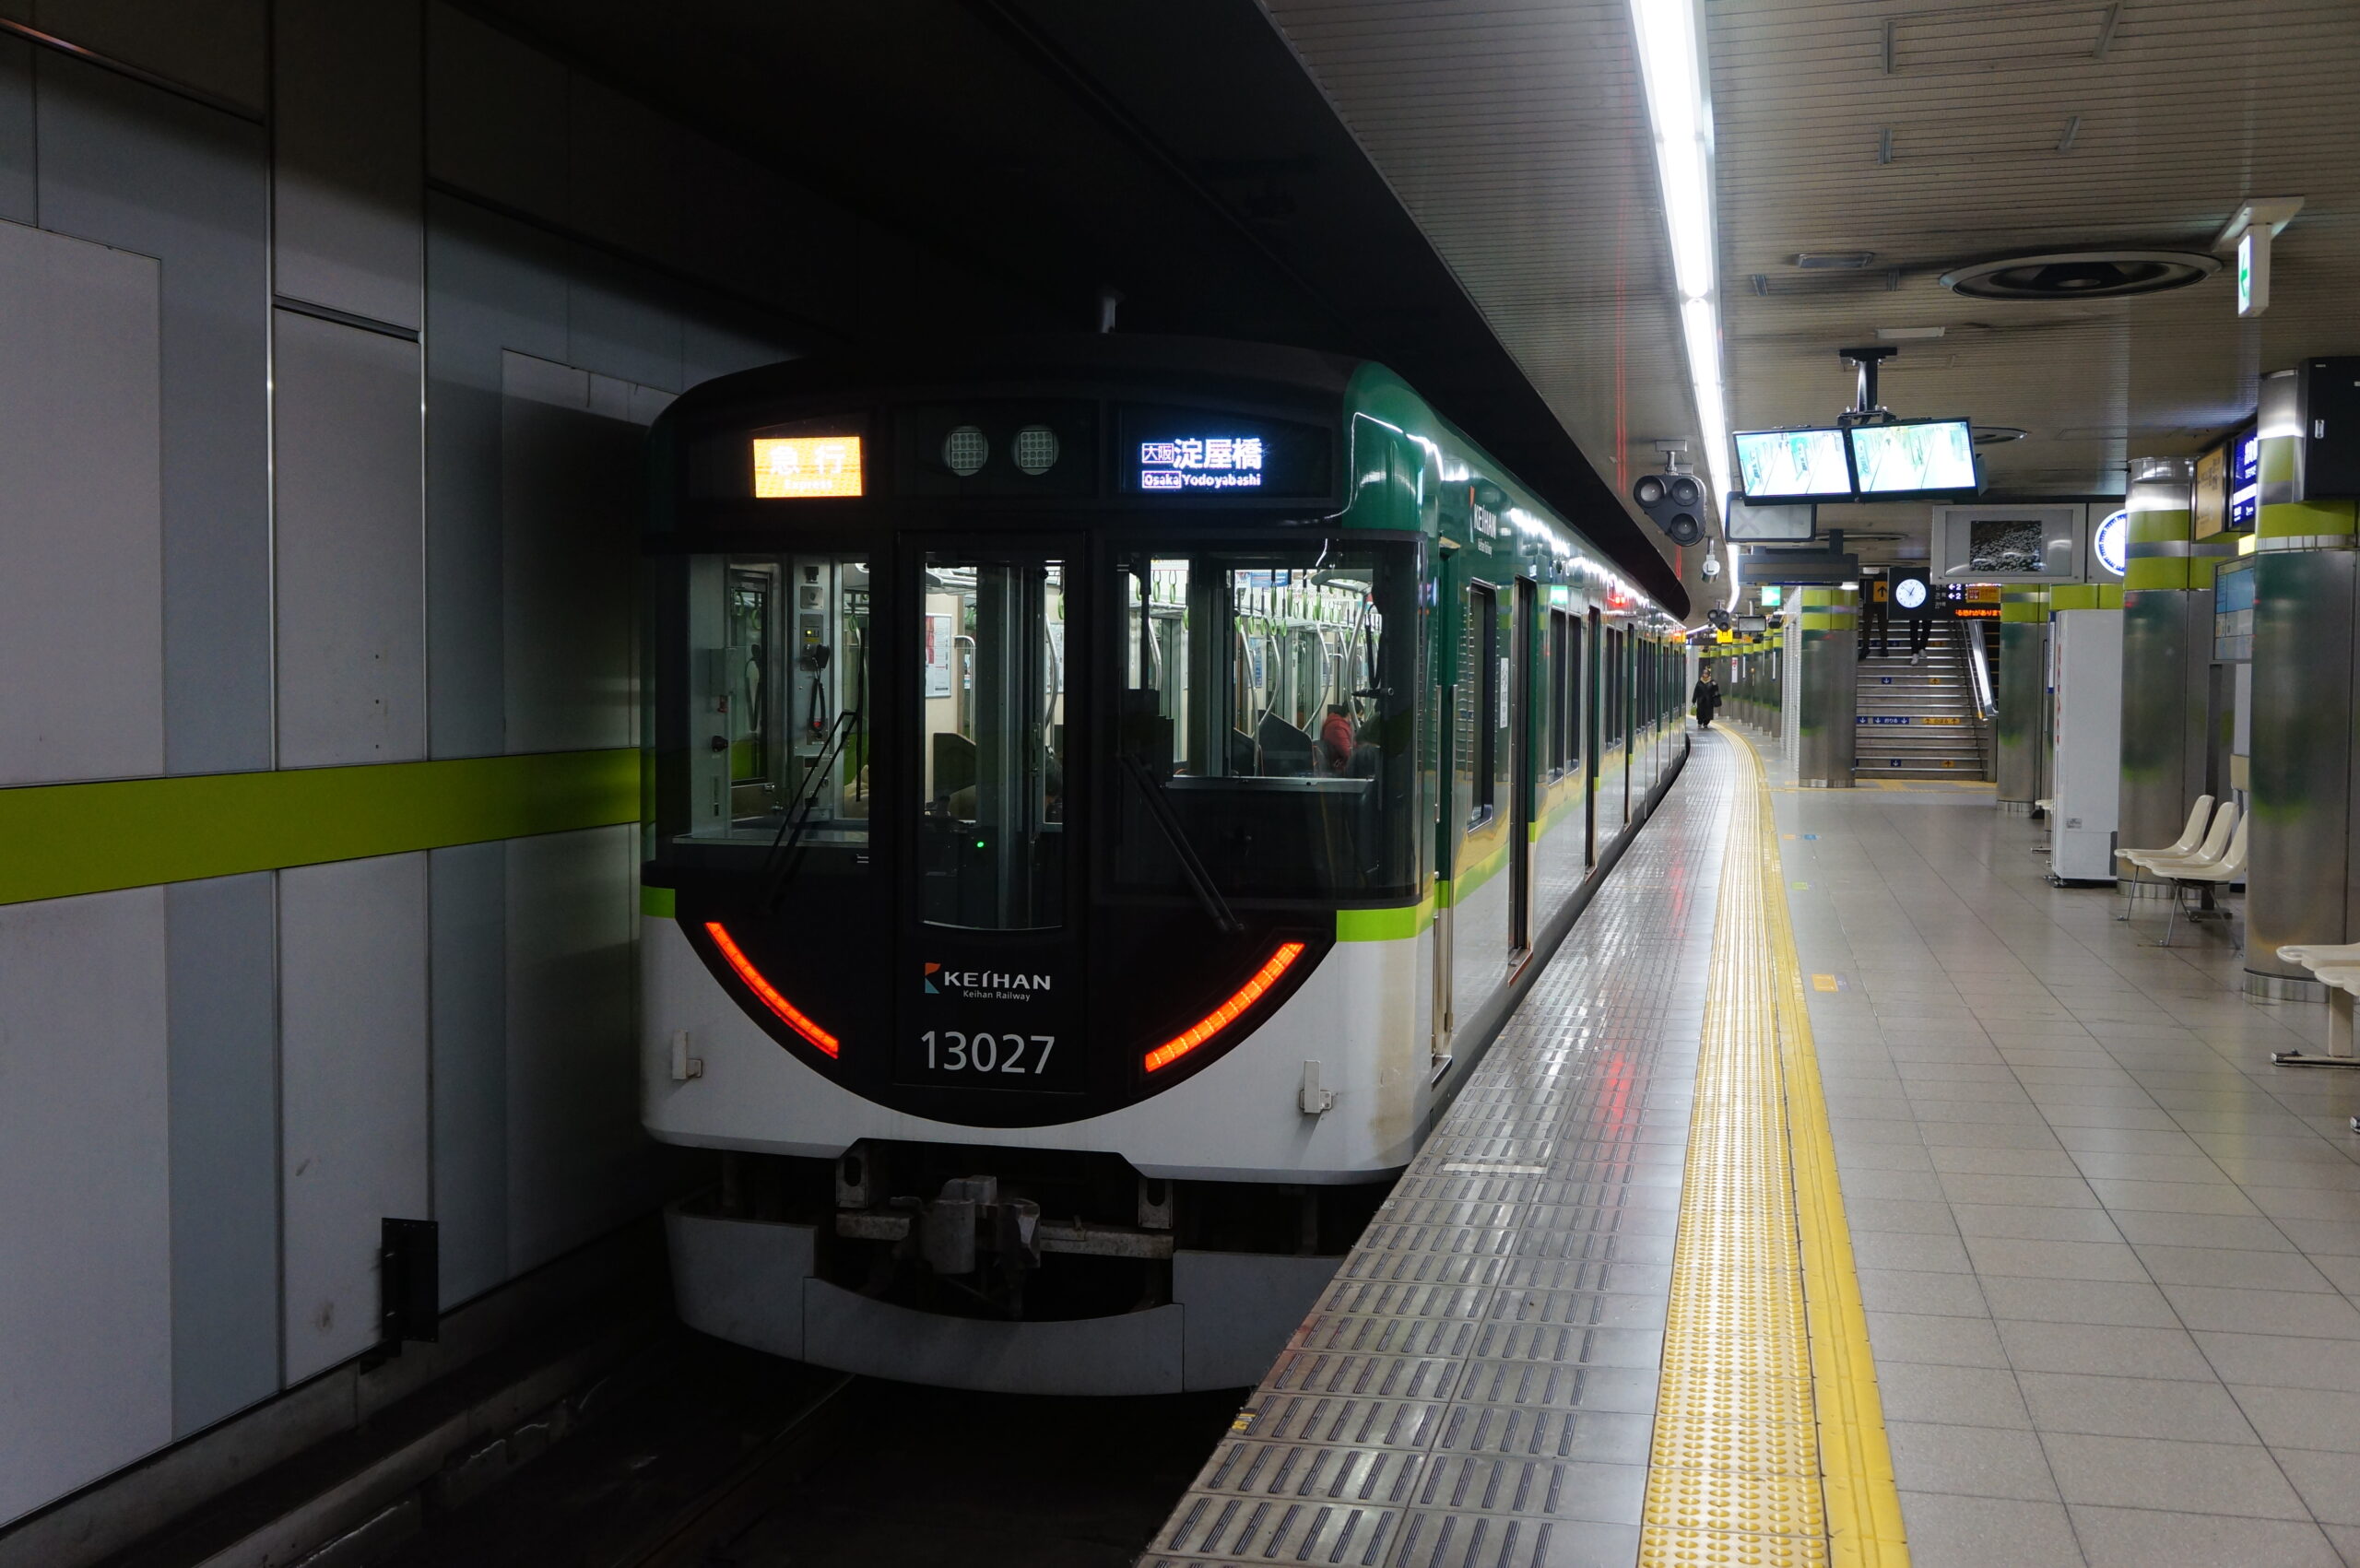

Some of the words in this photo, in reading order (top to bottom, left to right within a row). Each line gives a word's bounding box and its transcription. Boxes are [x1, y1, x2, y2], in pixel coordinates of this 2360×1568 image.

[769, 444, 846, 476] 急行
[1144, 445, 1172, 461] 大阪
[1173, 438, 1262, 469] 淀屋橋
[785, 479, 832, 492] Express
[1144, 474, 1180, 487] Osaka
[1182, 473, 1261, 489] Yodoyabashi
[1473, 503, 1496, 539] KEIHAN
[944, 971, 1051, 991] KEIHAN
[963, 990, 993, 999] Keihan
[996, 992, 1031, 1002] Railway
[921, 1031, 1056, 1075] 13027
